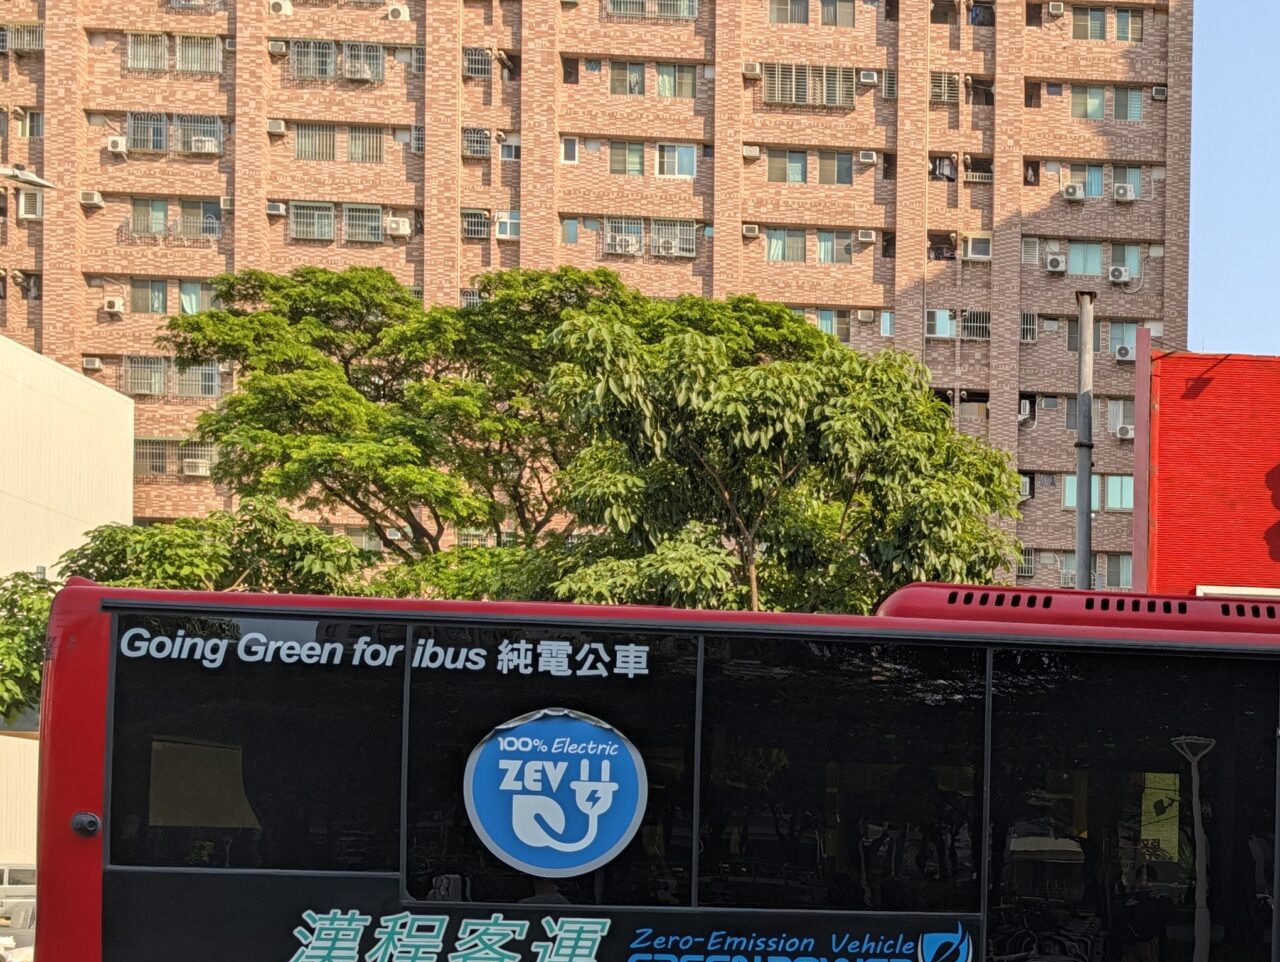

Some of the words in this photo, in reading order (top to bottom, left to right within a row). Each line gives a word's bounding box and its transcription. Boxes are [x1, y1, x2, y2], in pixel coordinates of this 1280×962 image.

[120, 627, 228, 668] Going
[236, 632, 344, 665] Green
[352, 635, 405, 667] for
[412, 638, 487, 670] ibus
[496, 639, 651, 679] 純電公車
[497, 736, 548, 754] 100%
[550, 737, 620, 757] Electric
[498, 759, 569, 792] ZEV
[629, 927, 816, 953] Zero-Emission
[831, 933, 915, 955] Vehicle
